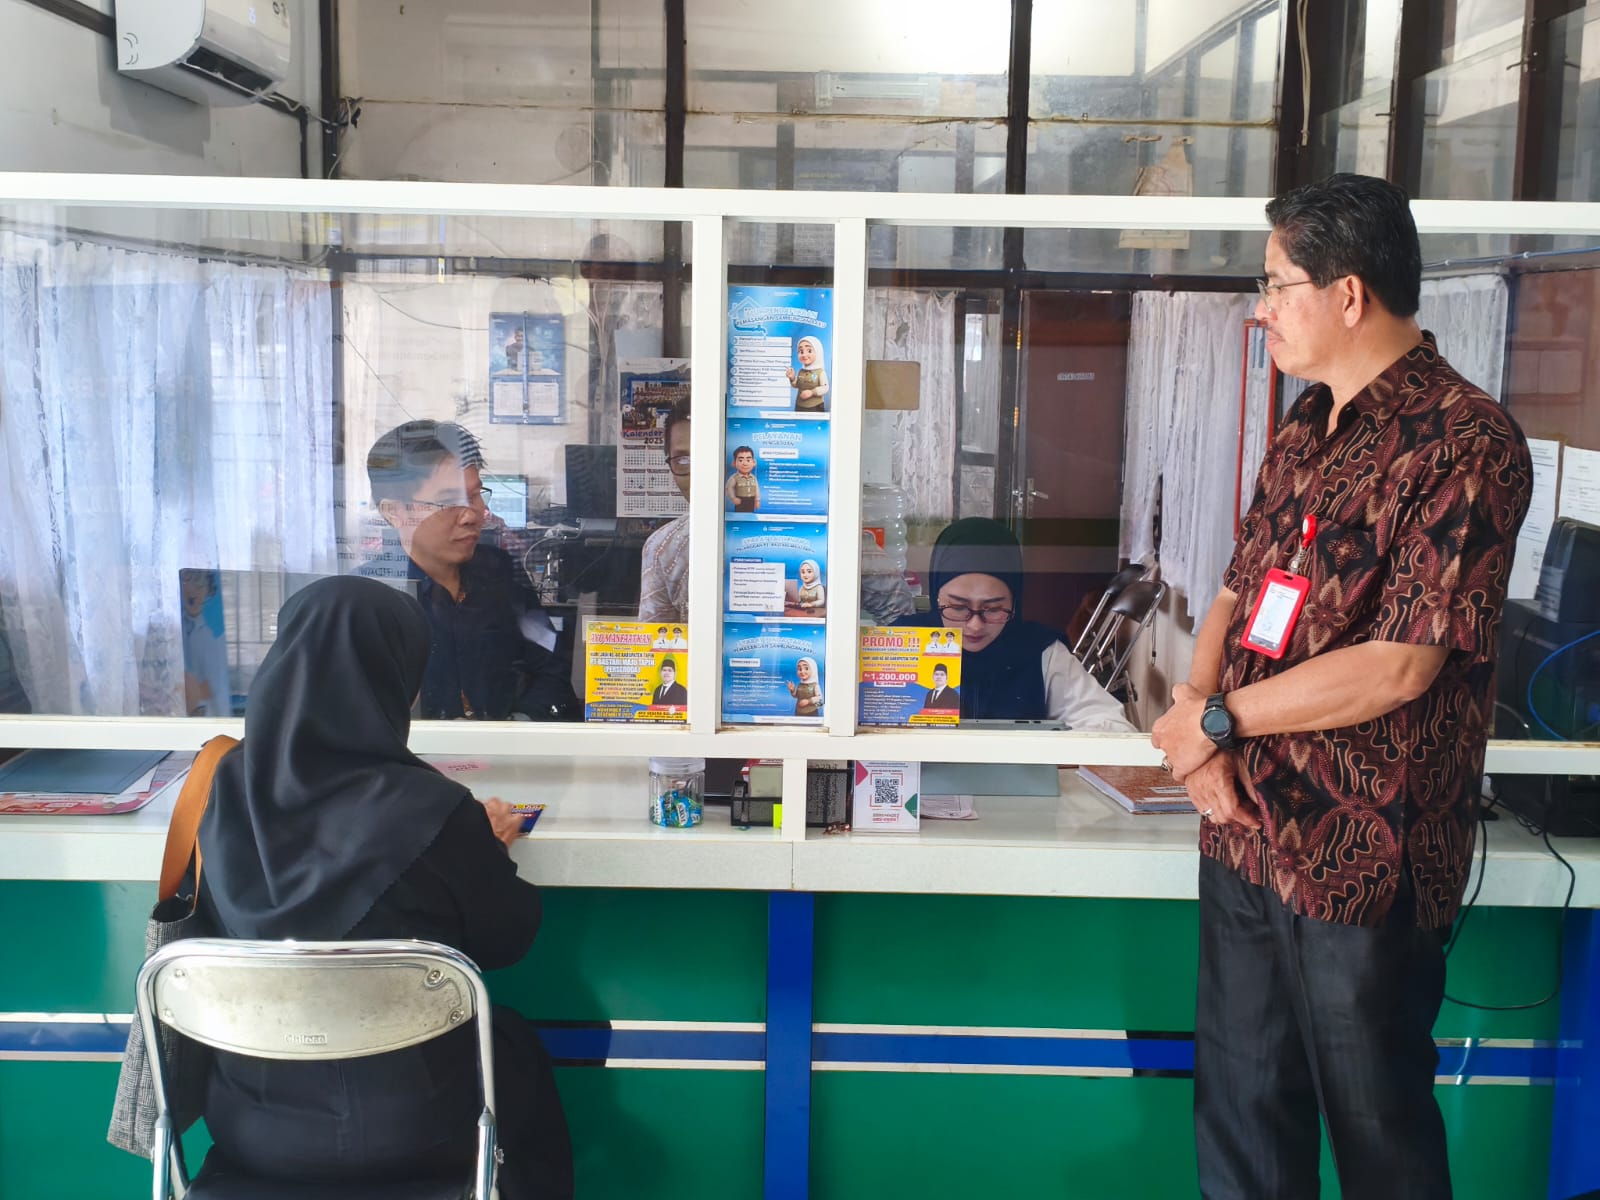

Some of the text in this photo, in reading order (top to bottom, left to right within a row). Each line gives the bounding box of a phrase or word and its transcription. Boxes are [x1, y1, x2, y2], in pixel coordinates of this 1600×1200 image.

[624, 430, 663, 438] Kalender
[752, 432, 802, 441] PELAYANAN
[862, 637, 920, 647] PROMO !!!
[871, 673, 916, 681] 1.200.000
